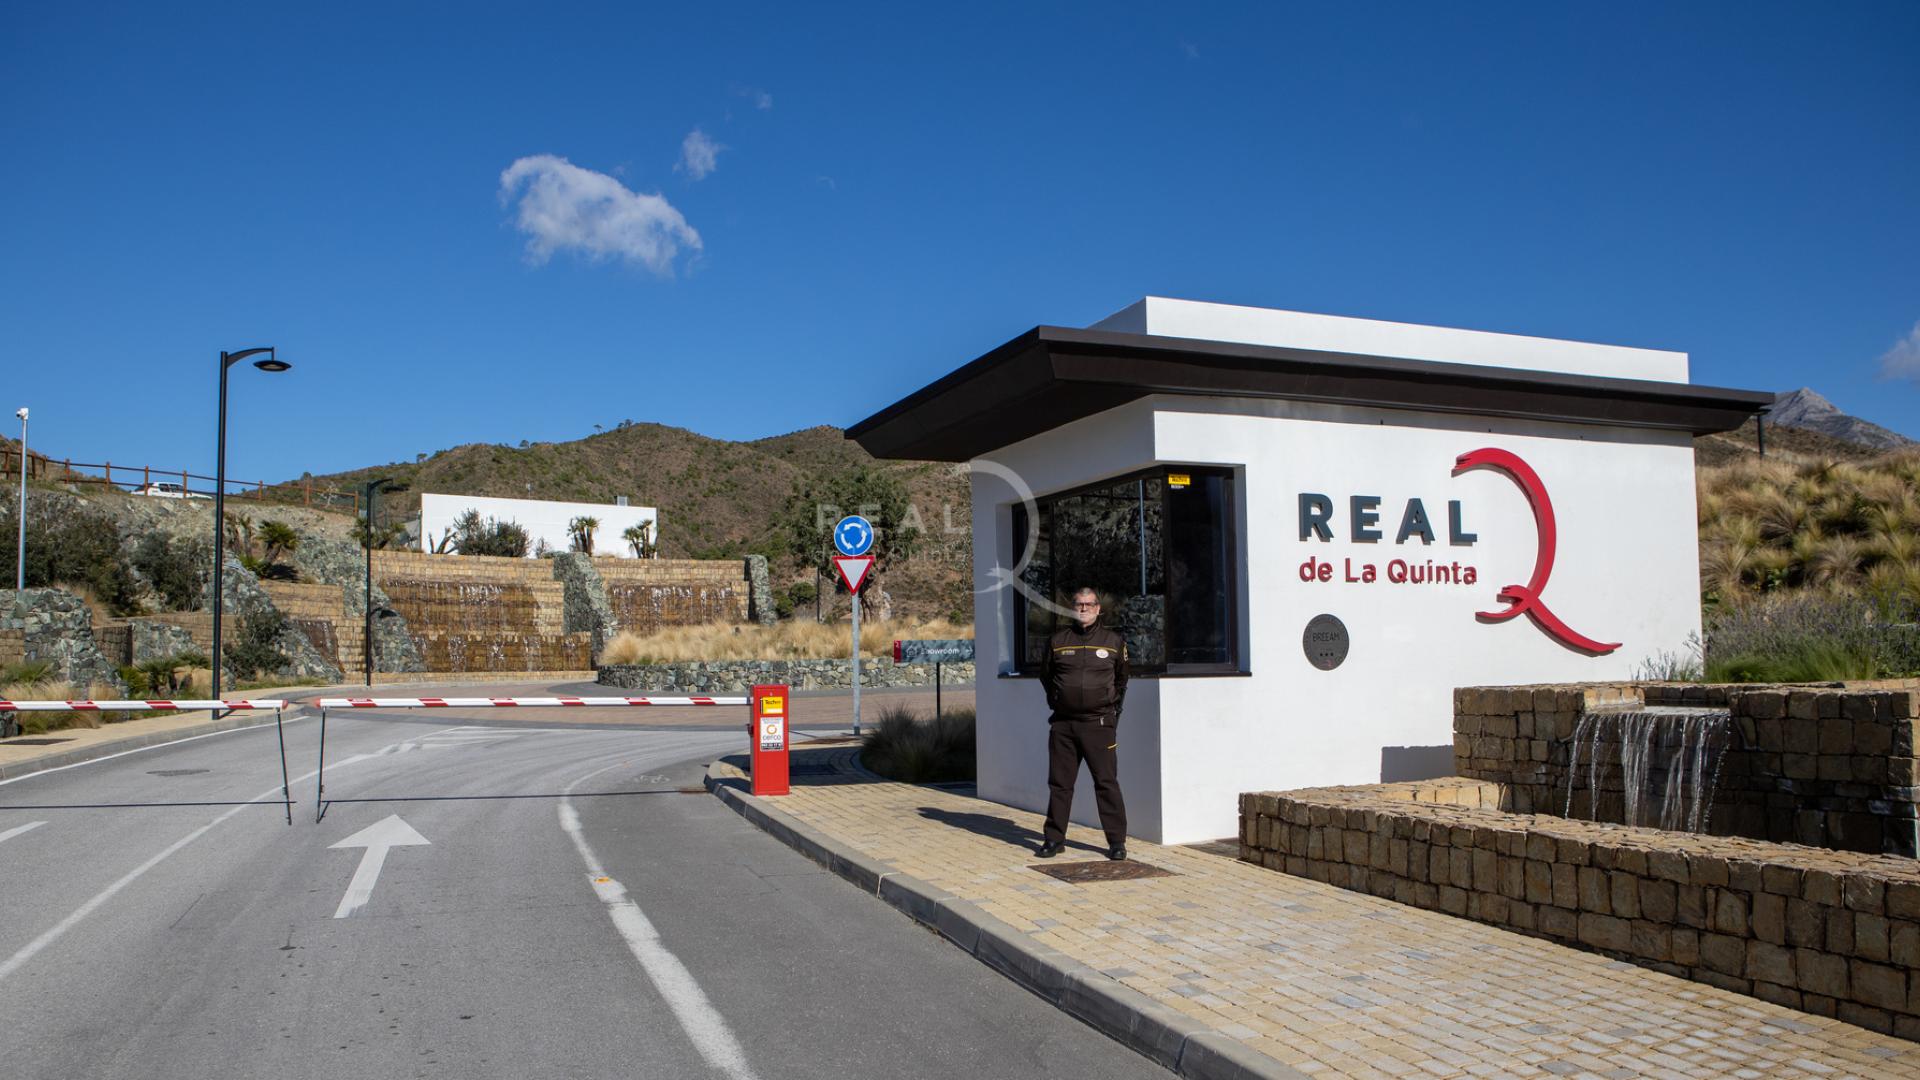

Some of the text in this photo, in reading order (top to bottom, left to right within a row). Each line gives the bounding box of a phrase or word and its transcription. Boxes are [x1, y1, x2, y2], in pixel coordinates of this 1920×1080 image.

[1298, 493, 1478, 547] REAL
[1299, 556, 1478, 585] de La Quinta
[1312, 631, 1341, 642] BREEAM
